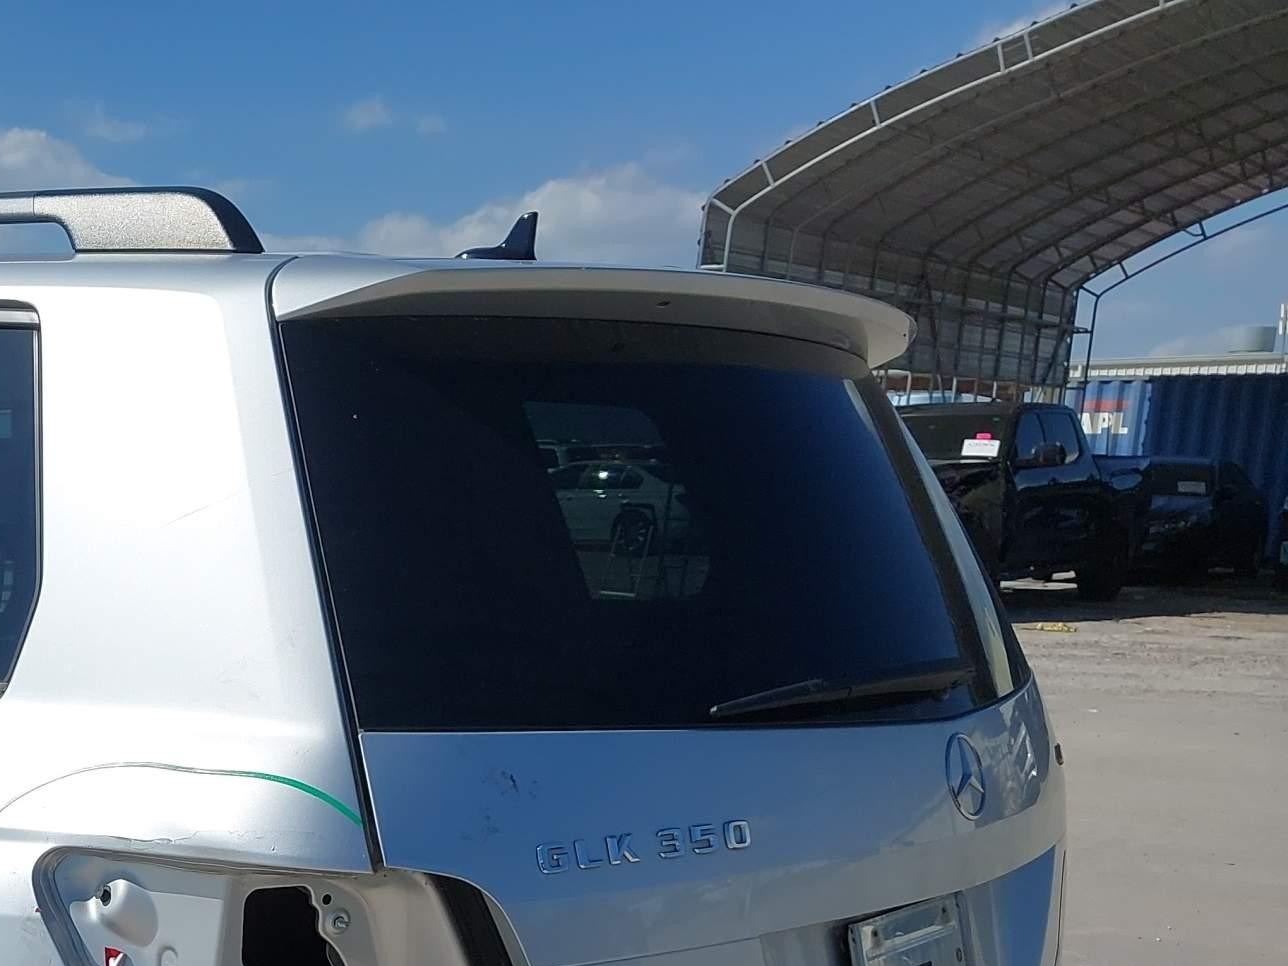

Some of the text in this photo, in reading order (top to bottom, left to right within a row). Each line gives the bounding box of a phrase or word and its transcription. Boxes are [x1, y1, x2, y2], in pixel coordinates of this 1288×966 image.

[1079, 412, 1129, 434] APL
[535, 819, 753, 875] GLK 350
